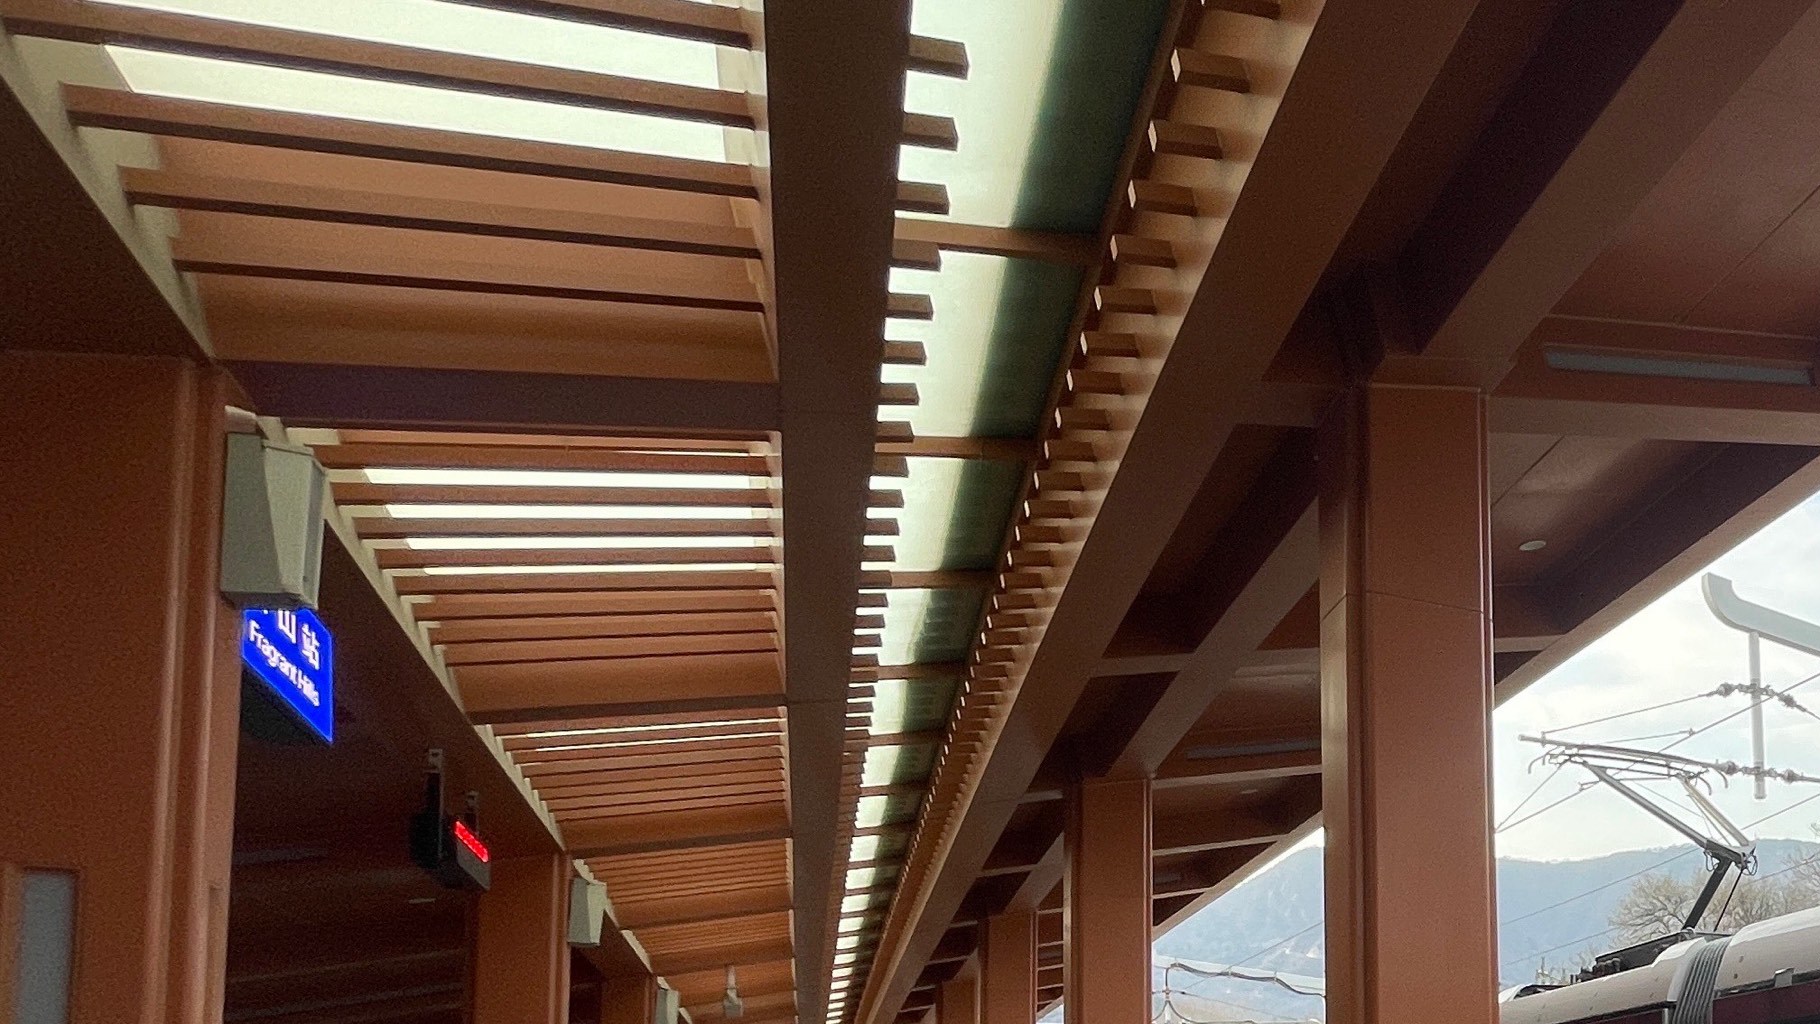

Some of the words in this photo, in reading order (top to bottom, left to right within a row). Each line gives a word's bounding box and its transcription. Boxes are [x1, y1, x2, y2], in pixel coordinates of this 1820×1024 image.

[249, 619, 298, 686] Fragrant
[297, 669, 320, 707] Hills
[262, 608, 320, 671] 山站
